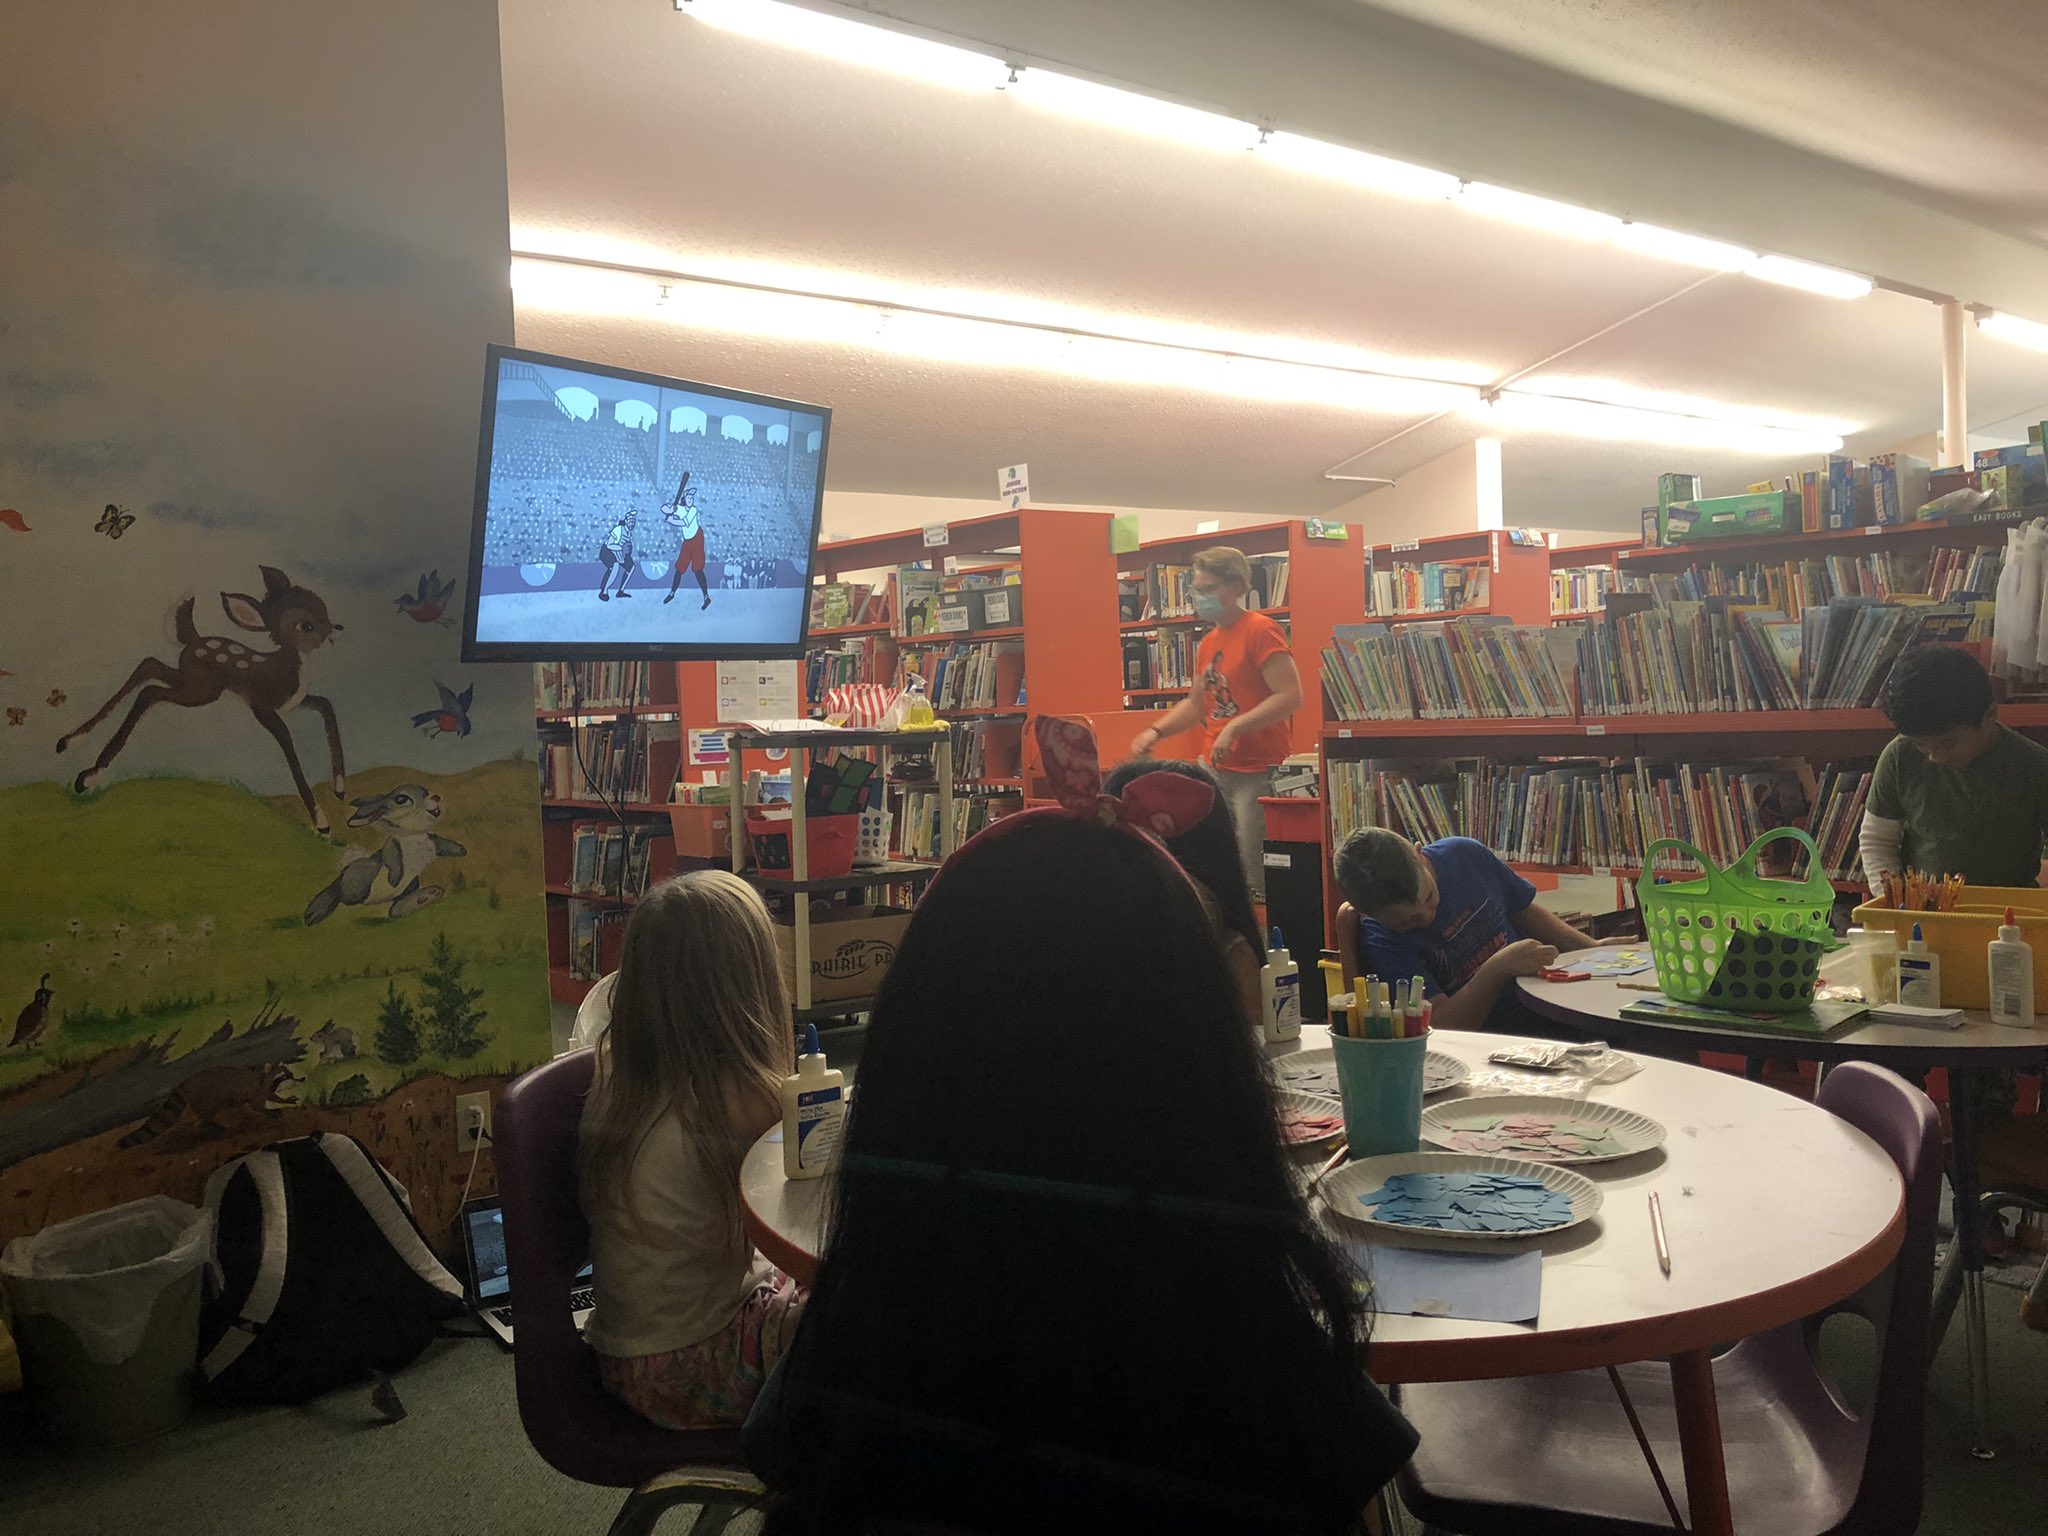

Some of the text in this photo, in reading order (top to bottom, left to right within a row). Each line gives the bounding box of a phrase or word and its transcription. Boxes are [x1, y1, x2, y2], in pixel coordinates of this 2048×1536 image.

[1975, 459, 1989, 468] 48
[1973, 510, 2022, 522] EASY BOOKS
[811, 955, 866, 975] RAIRIE
